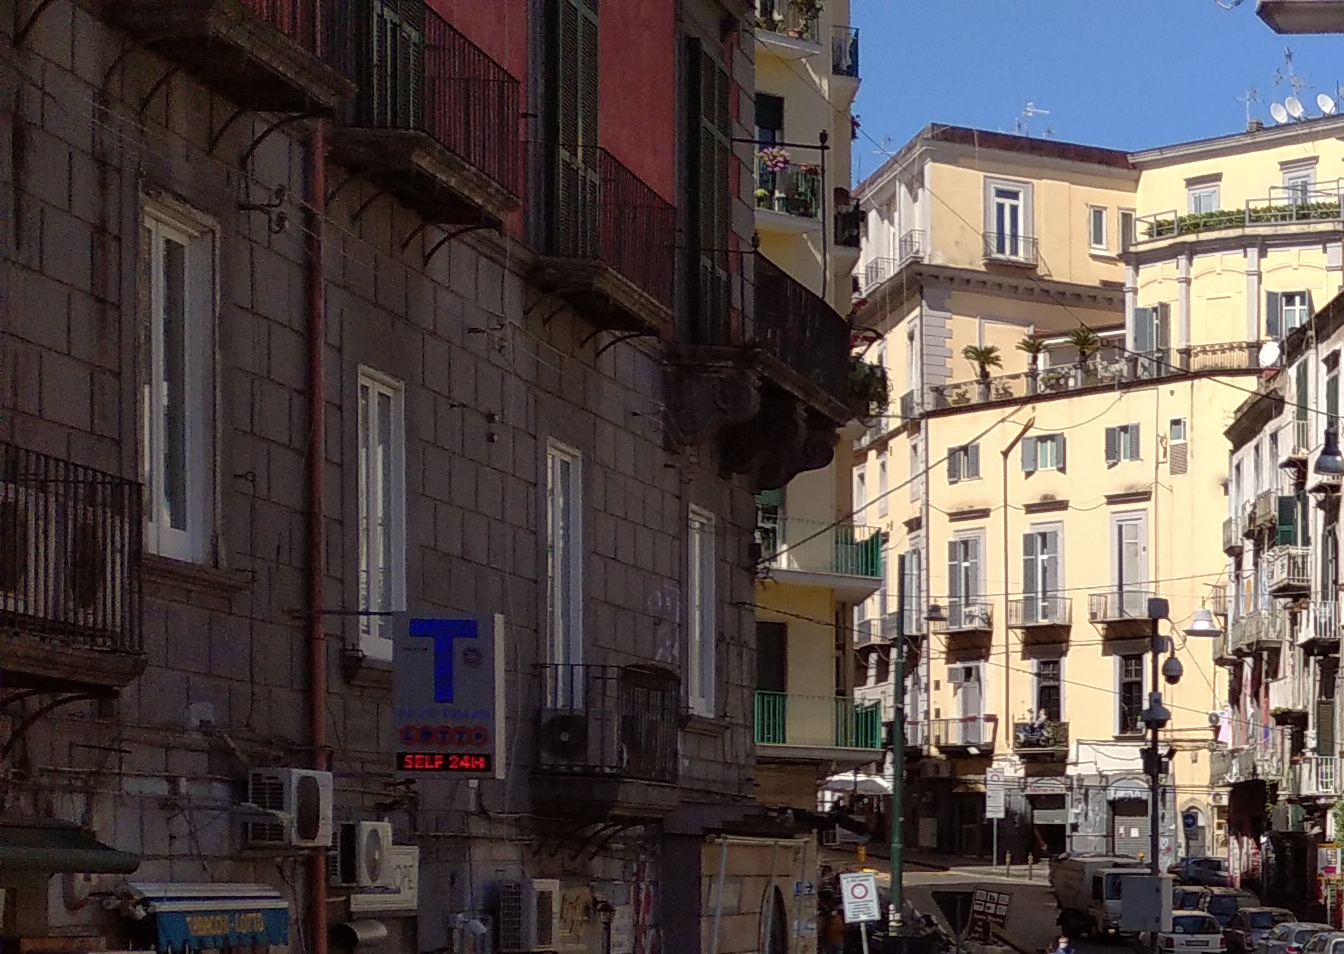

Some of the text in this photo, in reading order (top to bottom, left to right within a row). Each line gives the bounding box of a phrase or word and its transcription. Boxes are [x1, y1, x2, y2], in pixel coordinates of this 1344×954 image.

[409, 618, 478, 703] T
[403, 755, 487, 768] SELF 24H
